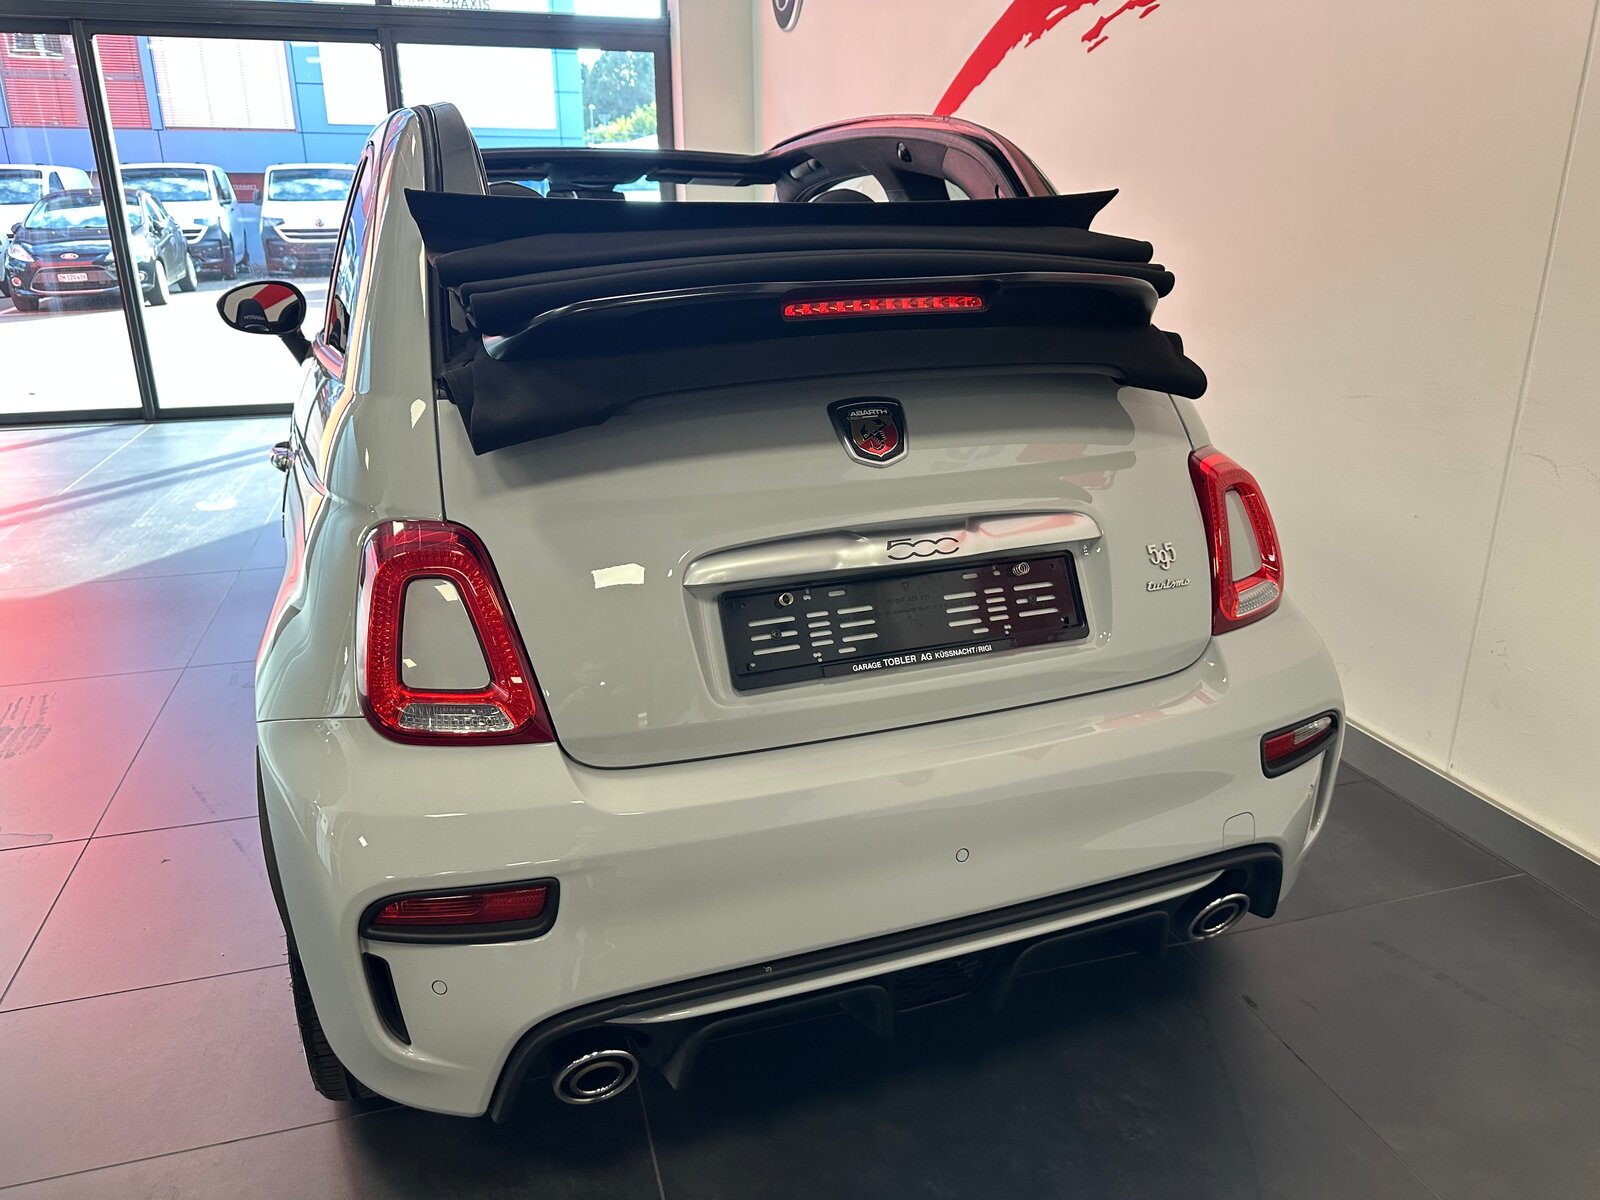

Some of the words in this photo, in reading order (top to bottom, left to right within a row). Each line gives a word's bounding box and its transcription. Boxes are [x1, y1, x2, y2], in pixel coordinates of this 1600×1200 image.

[850, 408, 888, 417] ABARTH
[886, 537, 960, 561] 500
[1145, 542, 1177, 571] 595
[1145, 578, 1190, 592] turismo
[852, 661, 882, 672] GARAGE
[882, 654, 917, 667] TOBLER
[920, 652, 933, 662] AG
[935, 644, 993, 659] KÜSSNACHT/RIGI
